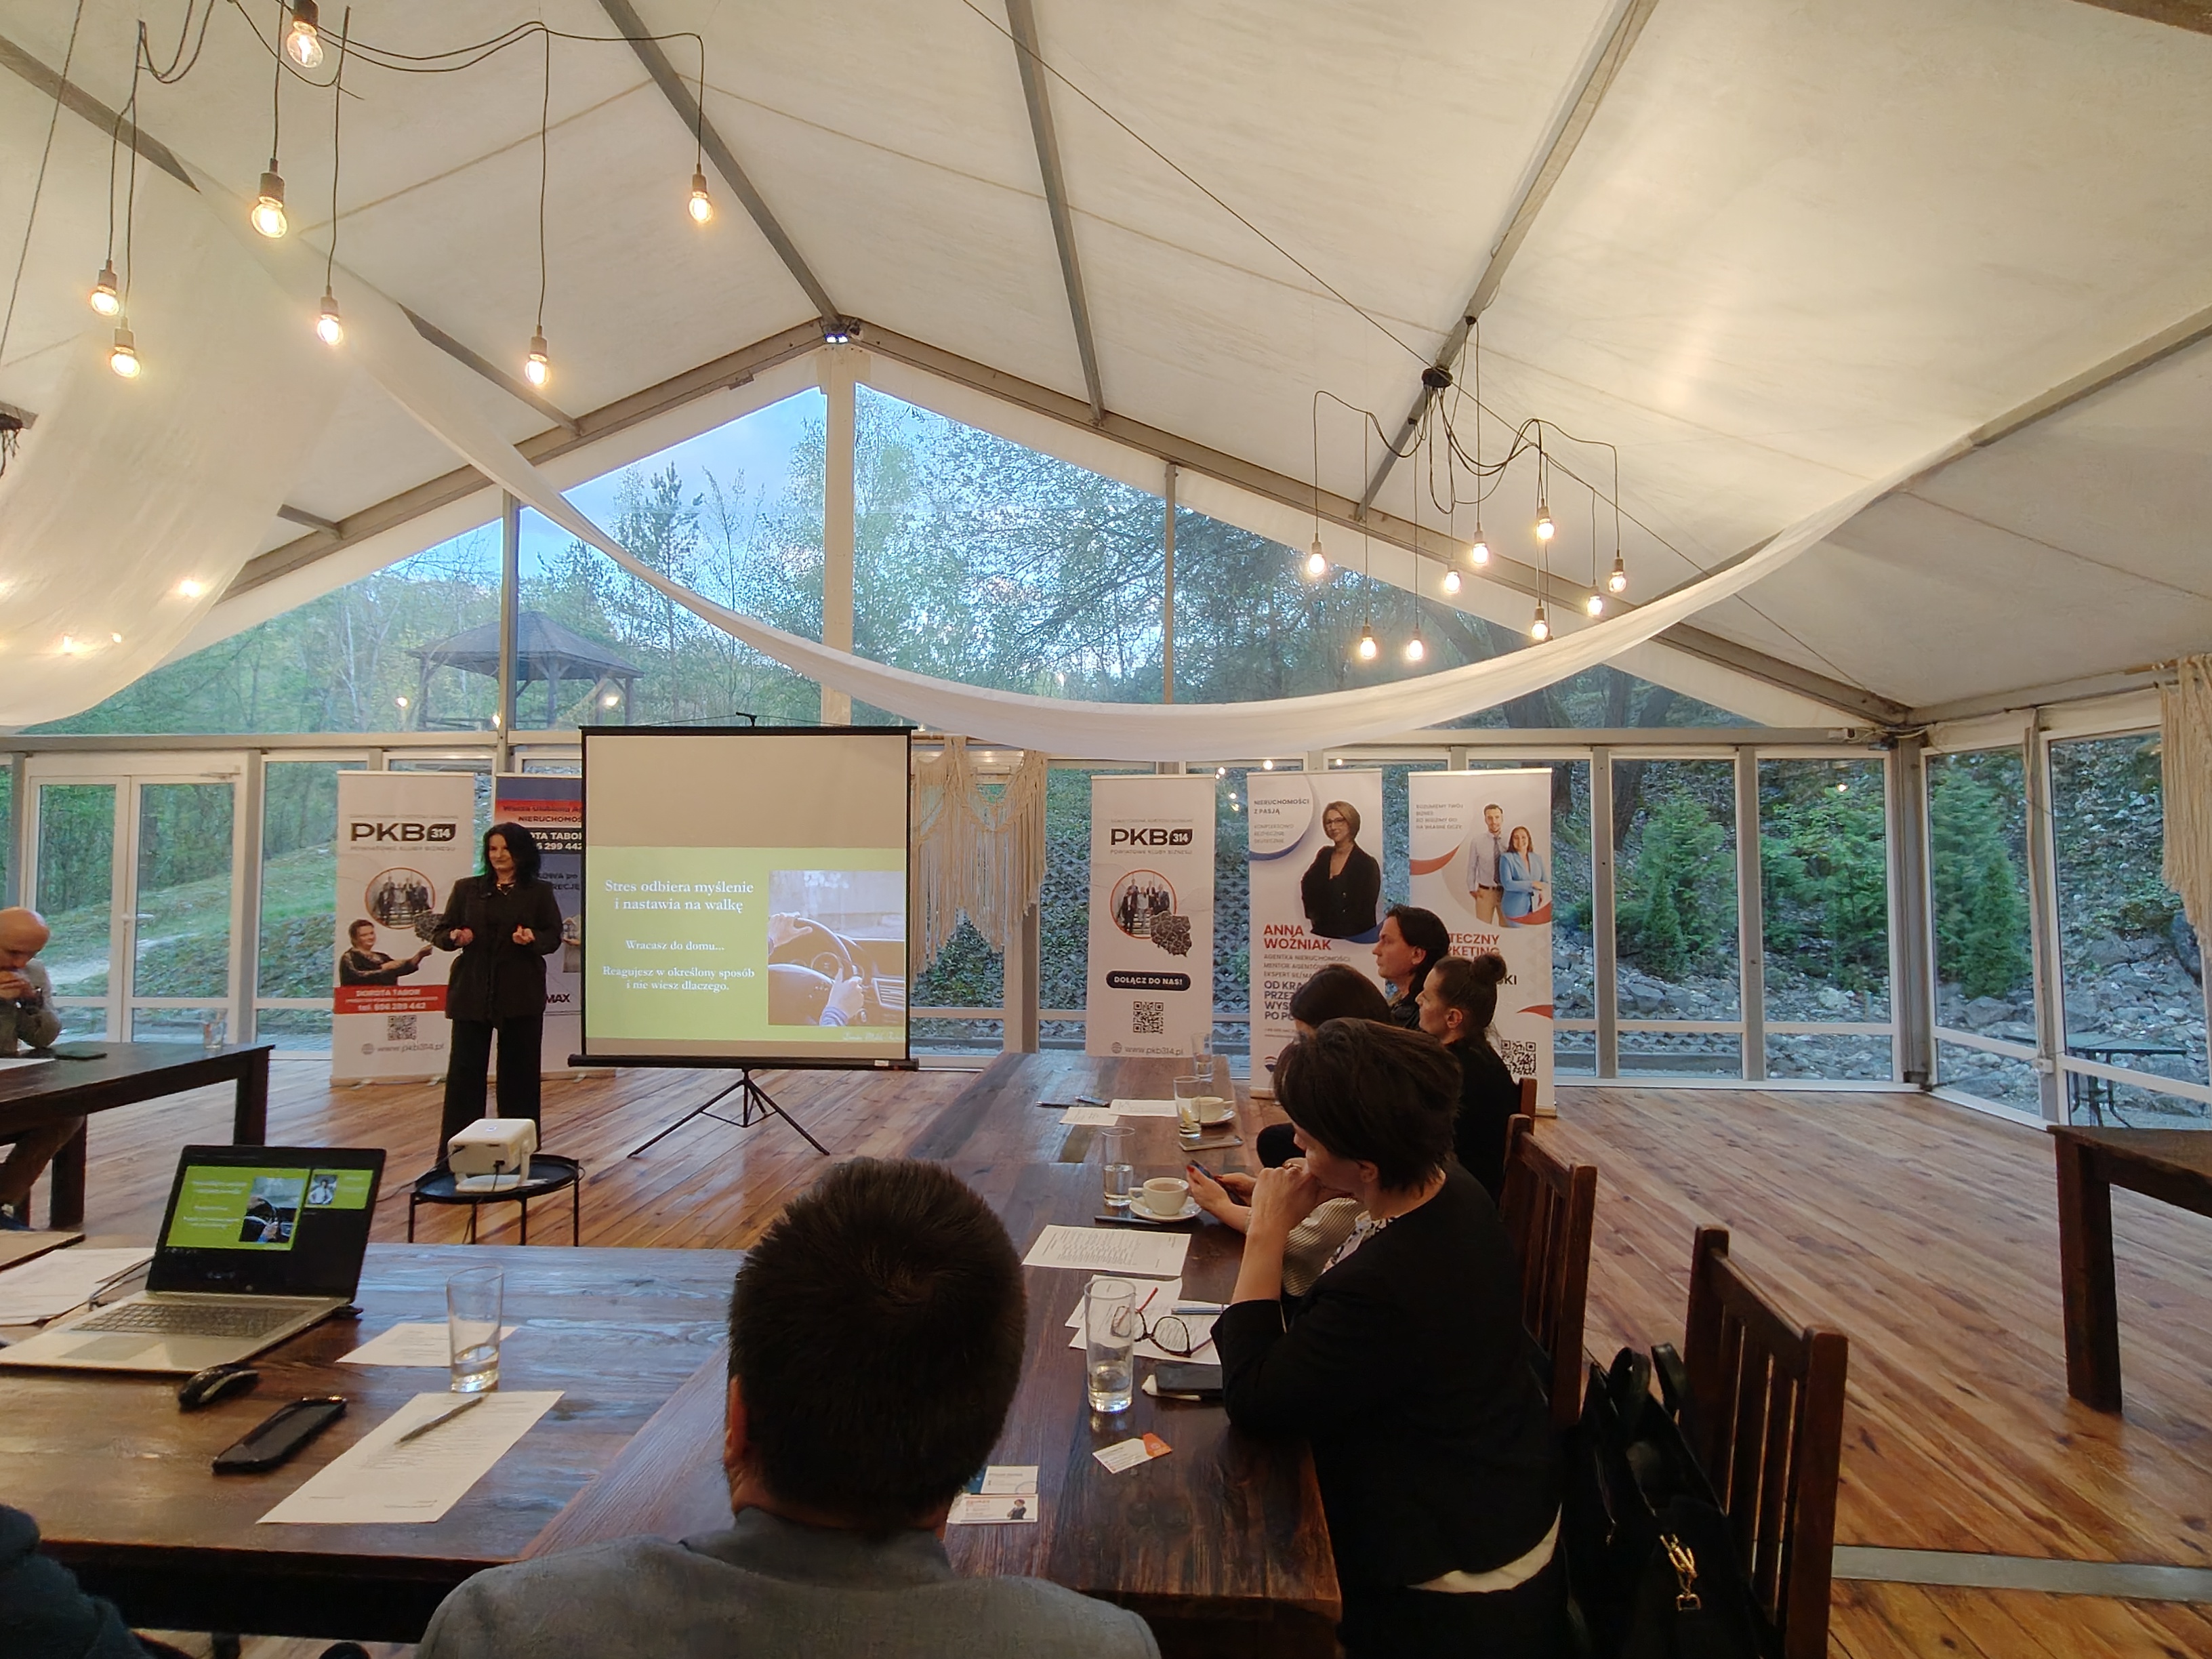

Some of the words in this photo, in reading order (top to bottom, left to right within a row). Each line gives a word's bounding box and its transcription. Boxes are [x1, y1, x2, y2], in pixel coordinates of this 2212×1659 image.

[350, 822, 425, 842] PKB
[430, 827, 451, 838] 314
[1110, 828, 1168, 846] PKB
[1172, 832, 1189, 842] 314
[605, 880, 637, 892] Stres
[640, 880, 691, 893] odbiera
[694, 880, 754, 896] myślenie
[614, 898, 619, 909] i
[622, 899, 681, 910] nastawia
[684, 901, 701, 910] na
[1263, 924, 1305, 936] ANNA
[625, 940, 667, 949] Wracasz
[670, 941, 683, 950] do
[685, 941, 725, 950] domu...
[1263, 935, 1332, 950] WOŹNIAK
[602, 966, 654, 979] Reagujesz
[668, 967, 716, 980] określony
[718, 968, 755, 980] sposób
[1113, 976, 1147, 985] DOŁĄCZ
[1264, 981, 1280, 989] OD
[626, 980, 631, 989] i
[632, 981, 649, 989] nie
[651, 980, 678, 989] wiesz
[681, 981, 730, 994] dlaczego.
[1265, 1002, 1291, 1010] WYS
[1265, 1011, 1280, 1020] PO
[1124, 1046, 1183, 1056] www.pkb314.pl
